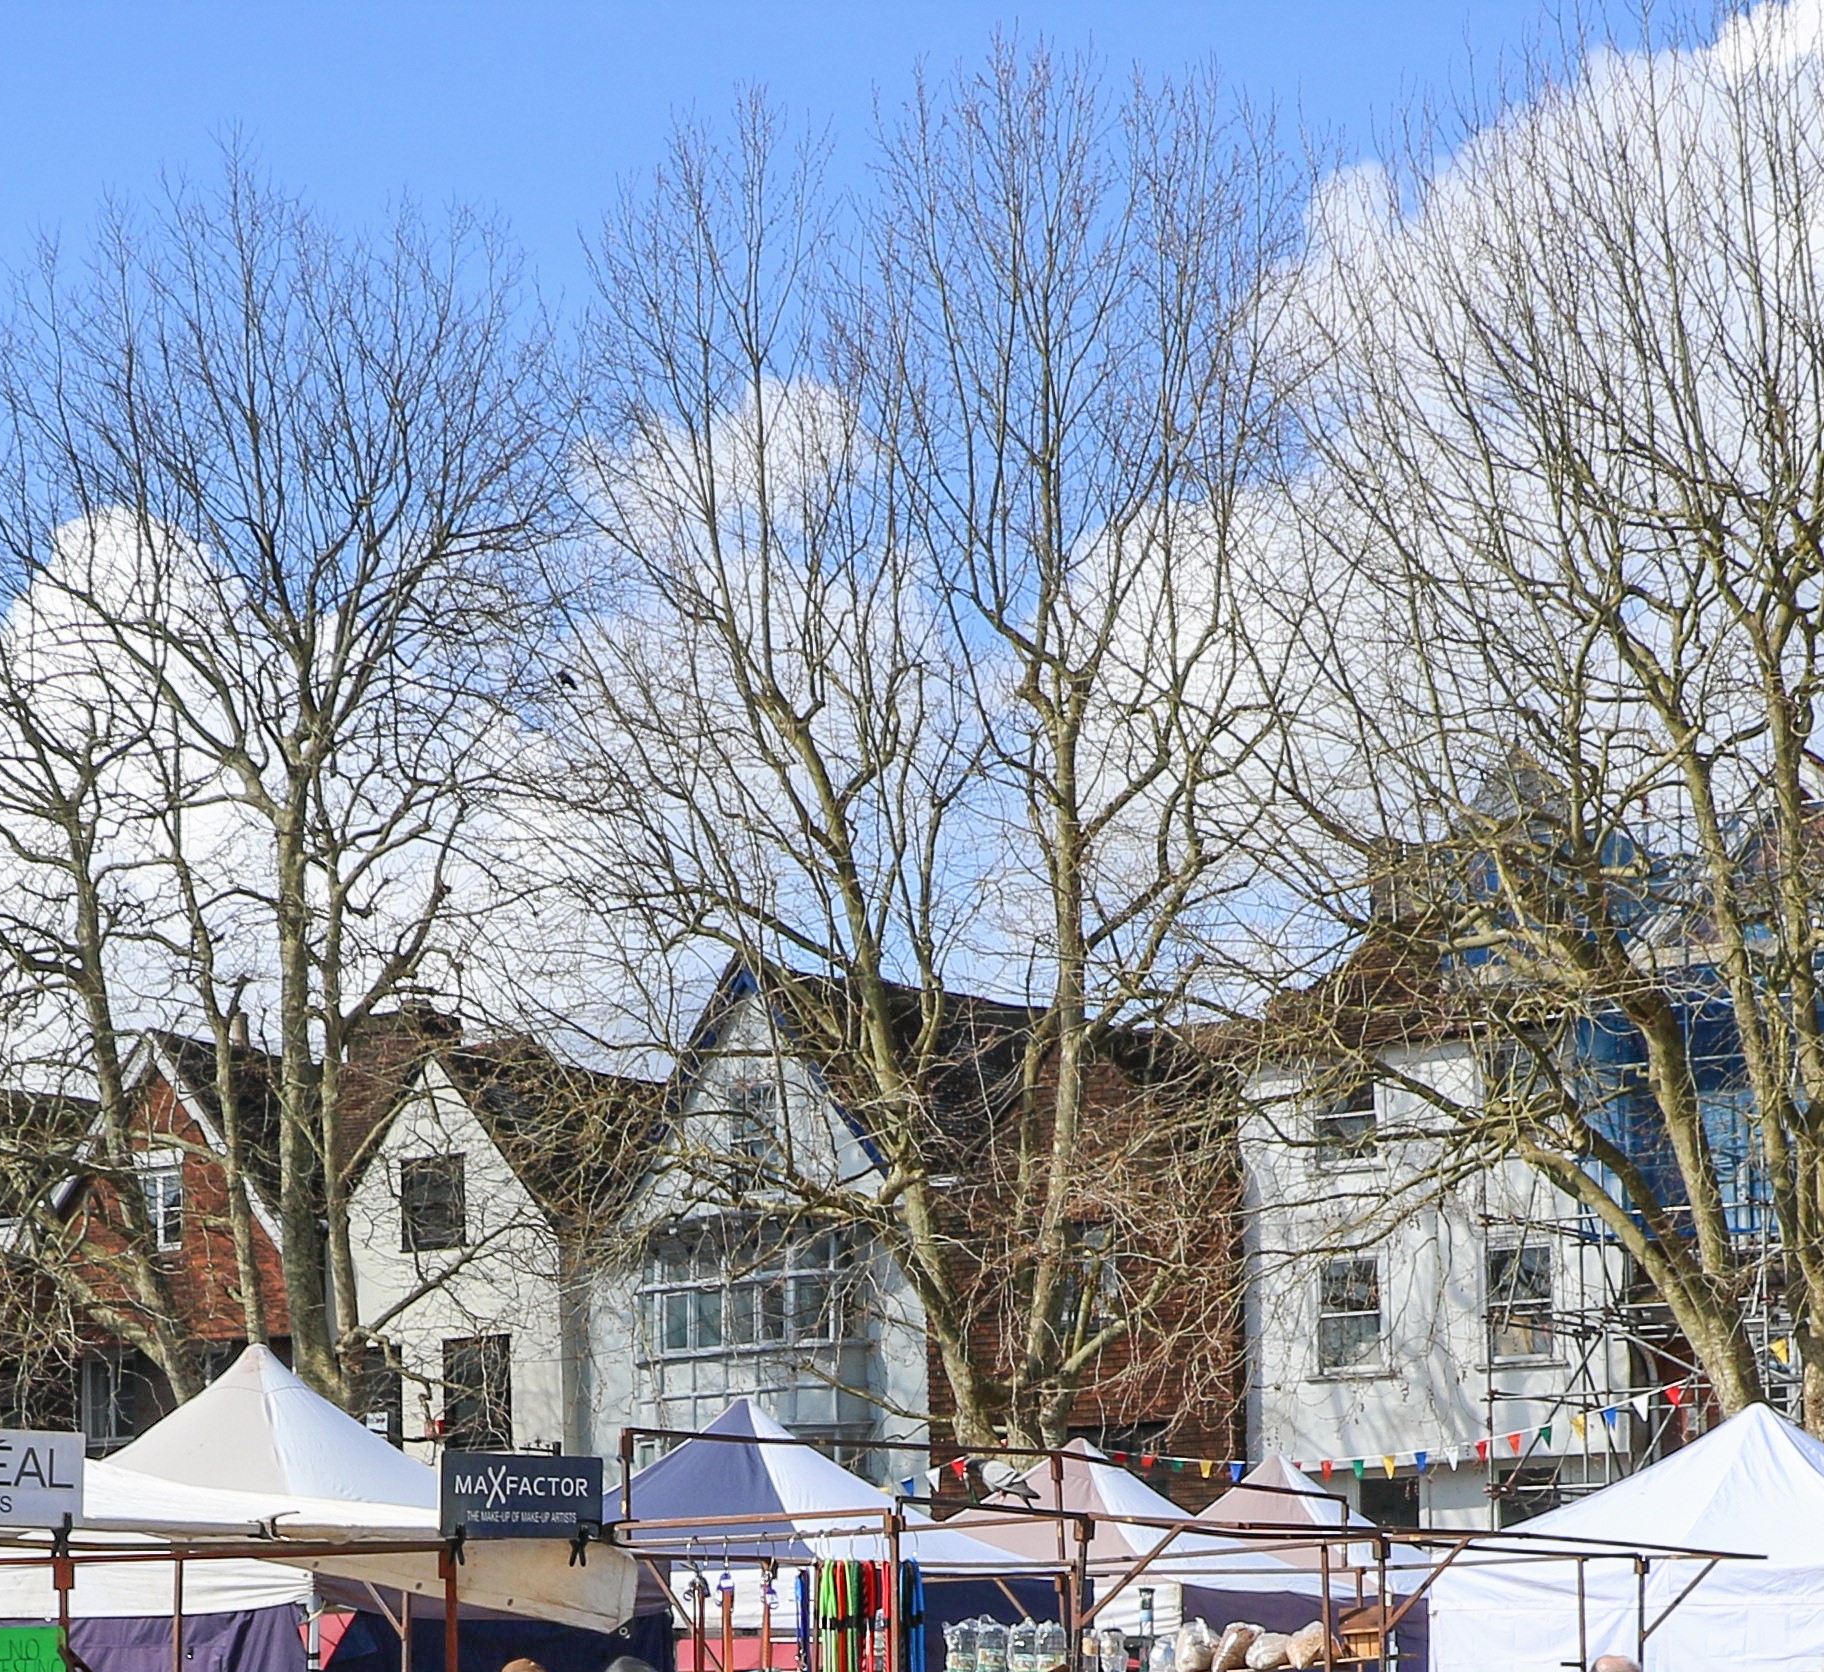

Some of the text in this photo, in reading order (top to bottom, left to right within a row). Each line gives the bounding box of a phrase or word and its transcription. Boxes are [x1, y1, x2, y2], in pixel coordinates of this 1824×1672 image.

[467, 1510, 577, 1524] THE MAKE-UP OF MAKE-UP ARTISTS
[9, 1638, 40, 1660] NO
